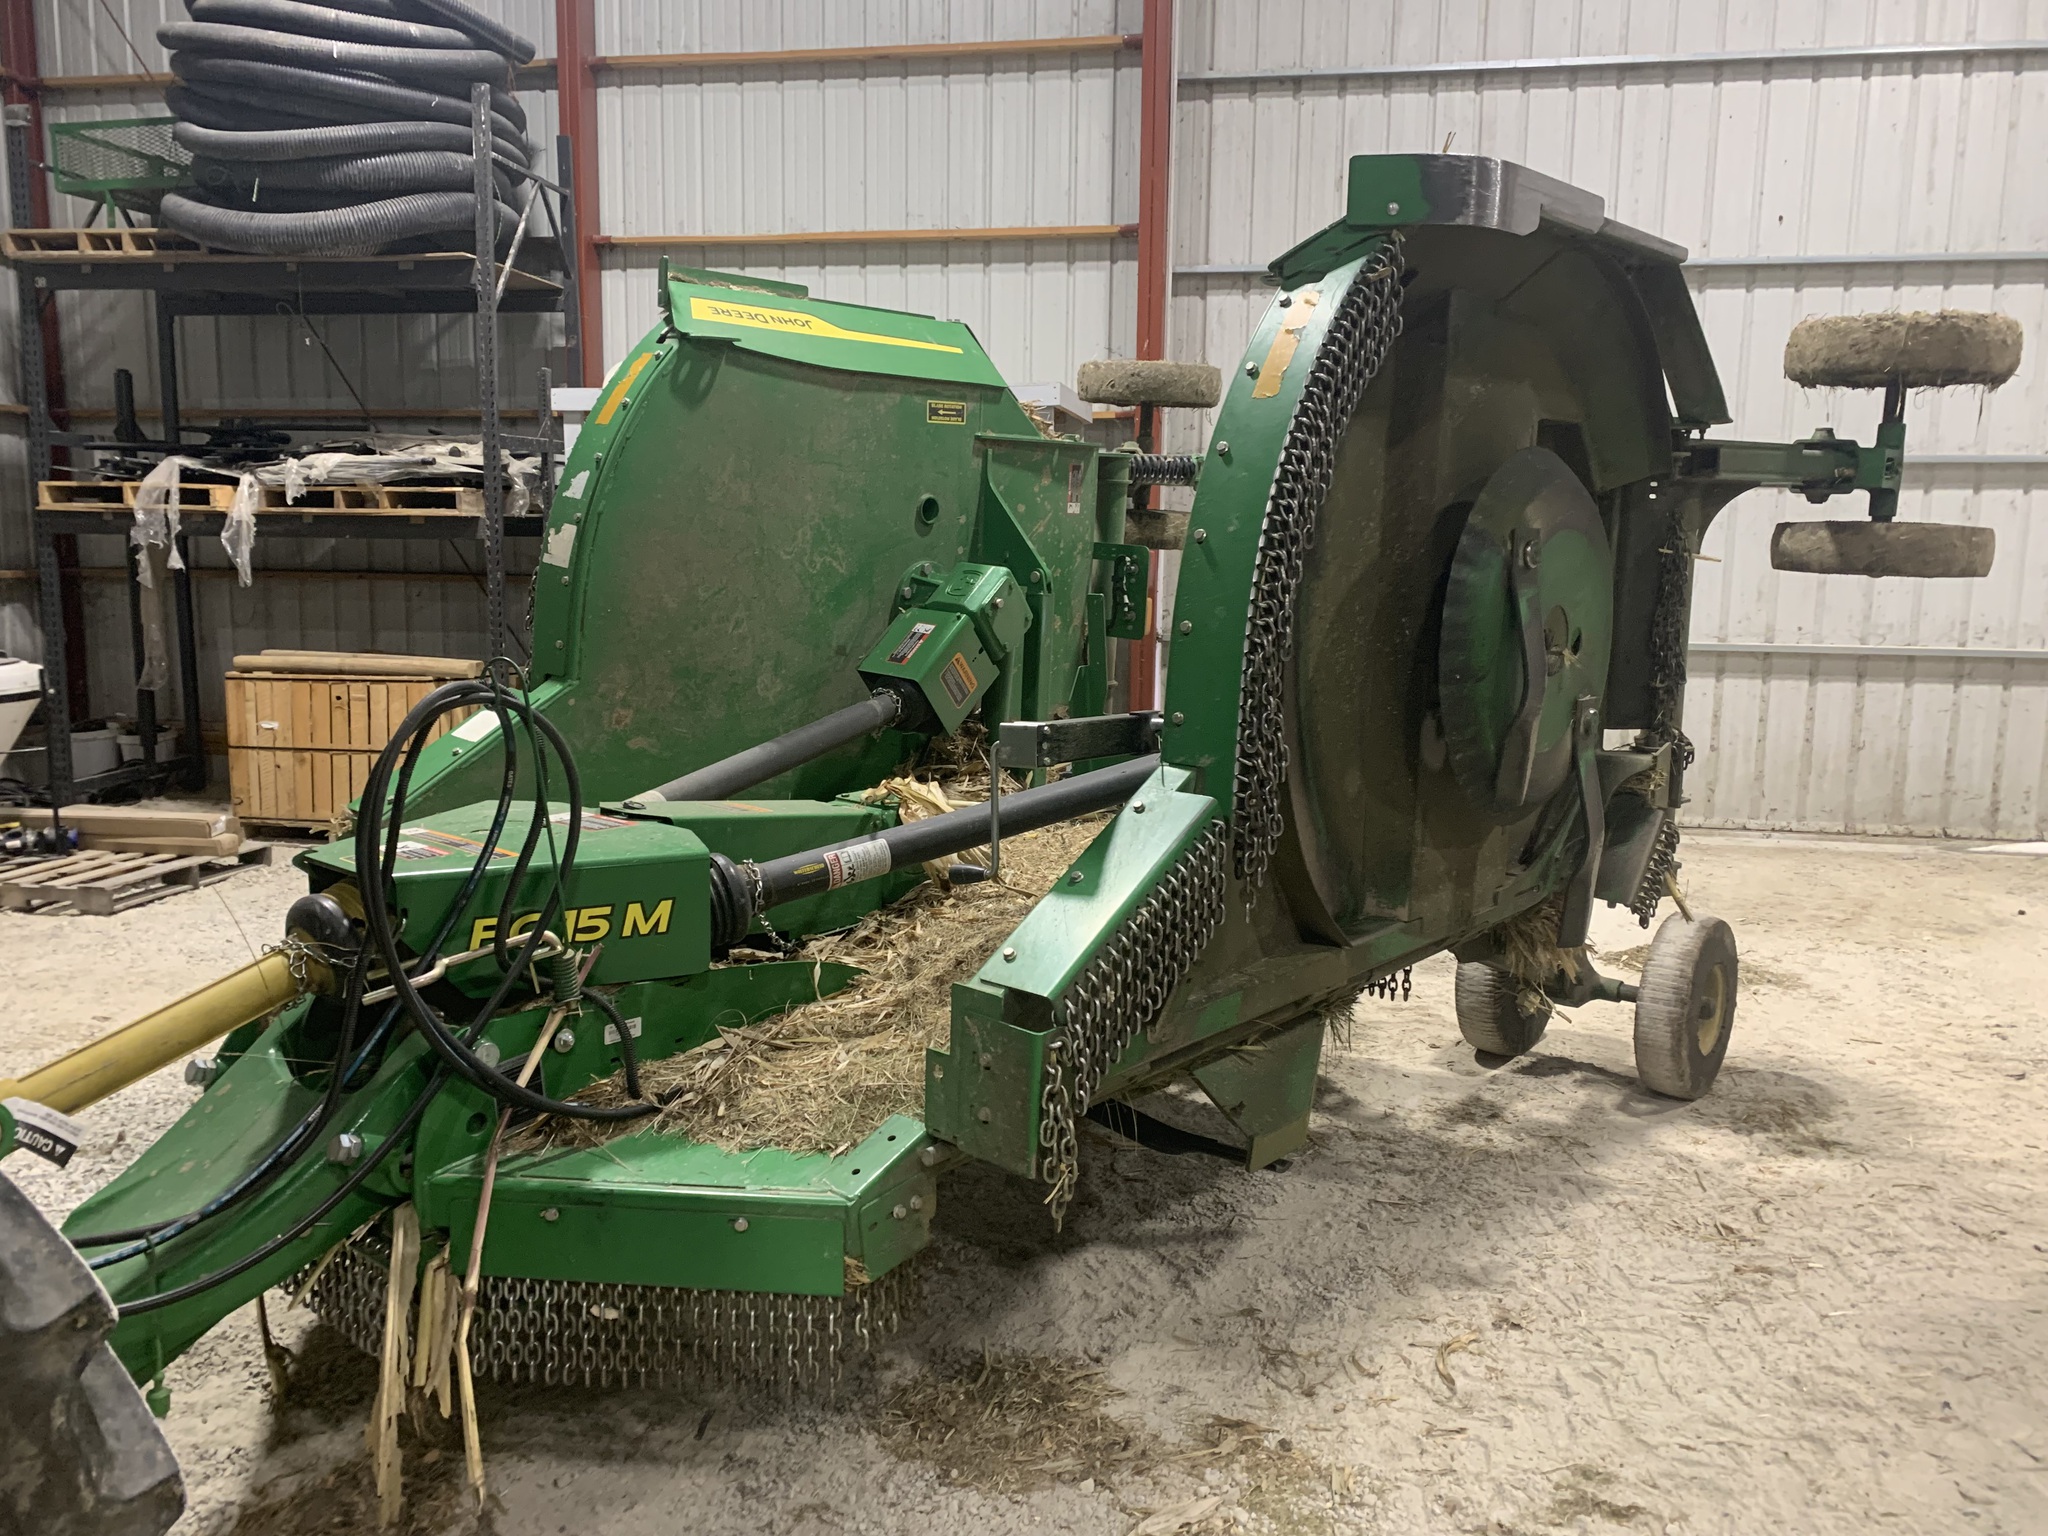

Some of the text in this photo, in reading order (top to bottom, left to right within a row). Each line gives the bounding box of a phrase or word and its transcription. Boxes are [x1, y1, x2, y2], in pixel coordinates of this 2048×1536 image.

[707, 305, 813, 330] JOHN DEERE
[958, 663, 975, 690] WARNING
[827, 853, 841, 883] DANGER
[620, 898, 675, 939] M
[14, 1127, 54, 1152] CAUTIO
